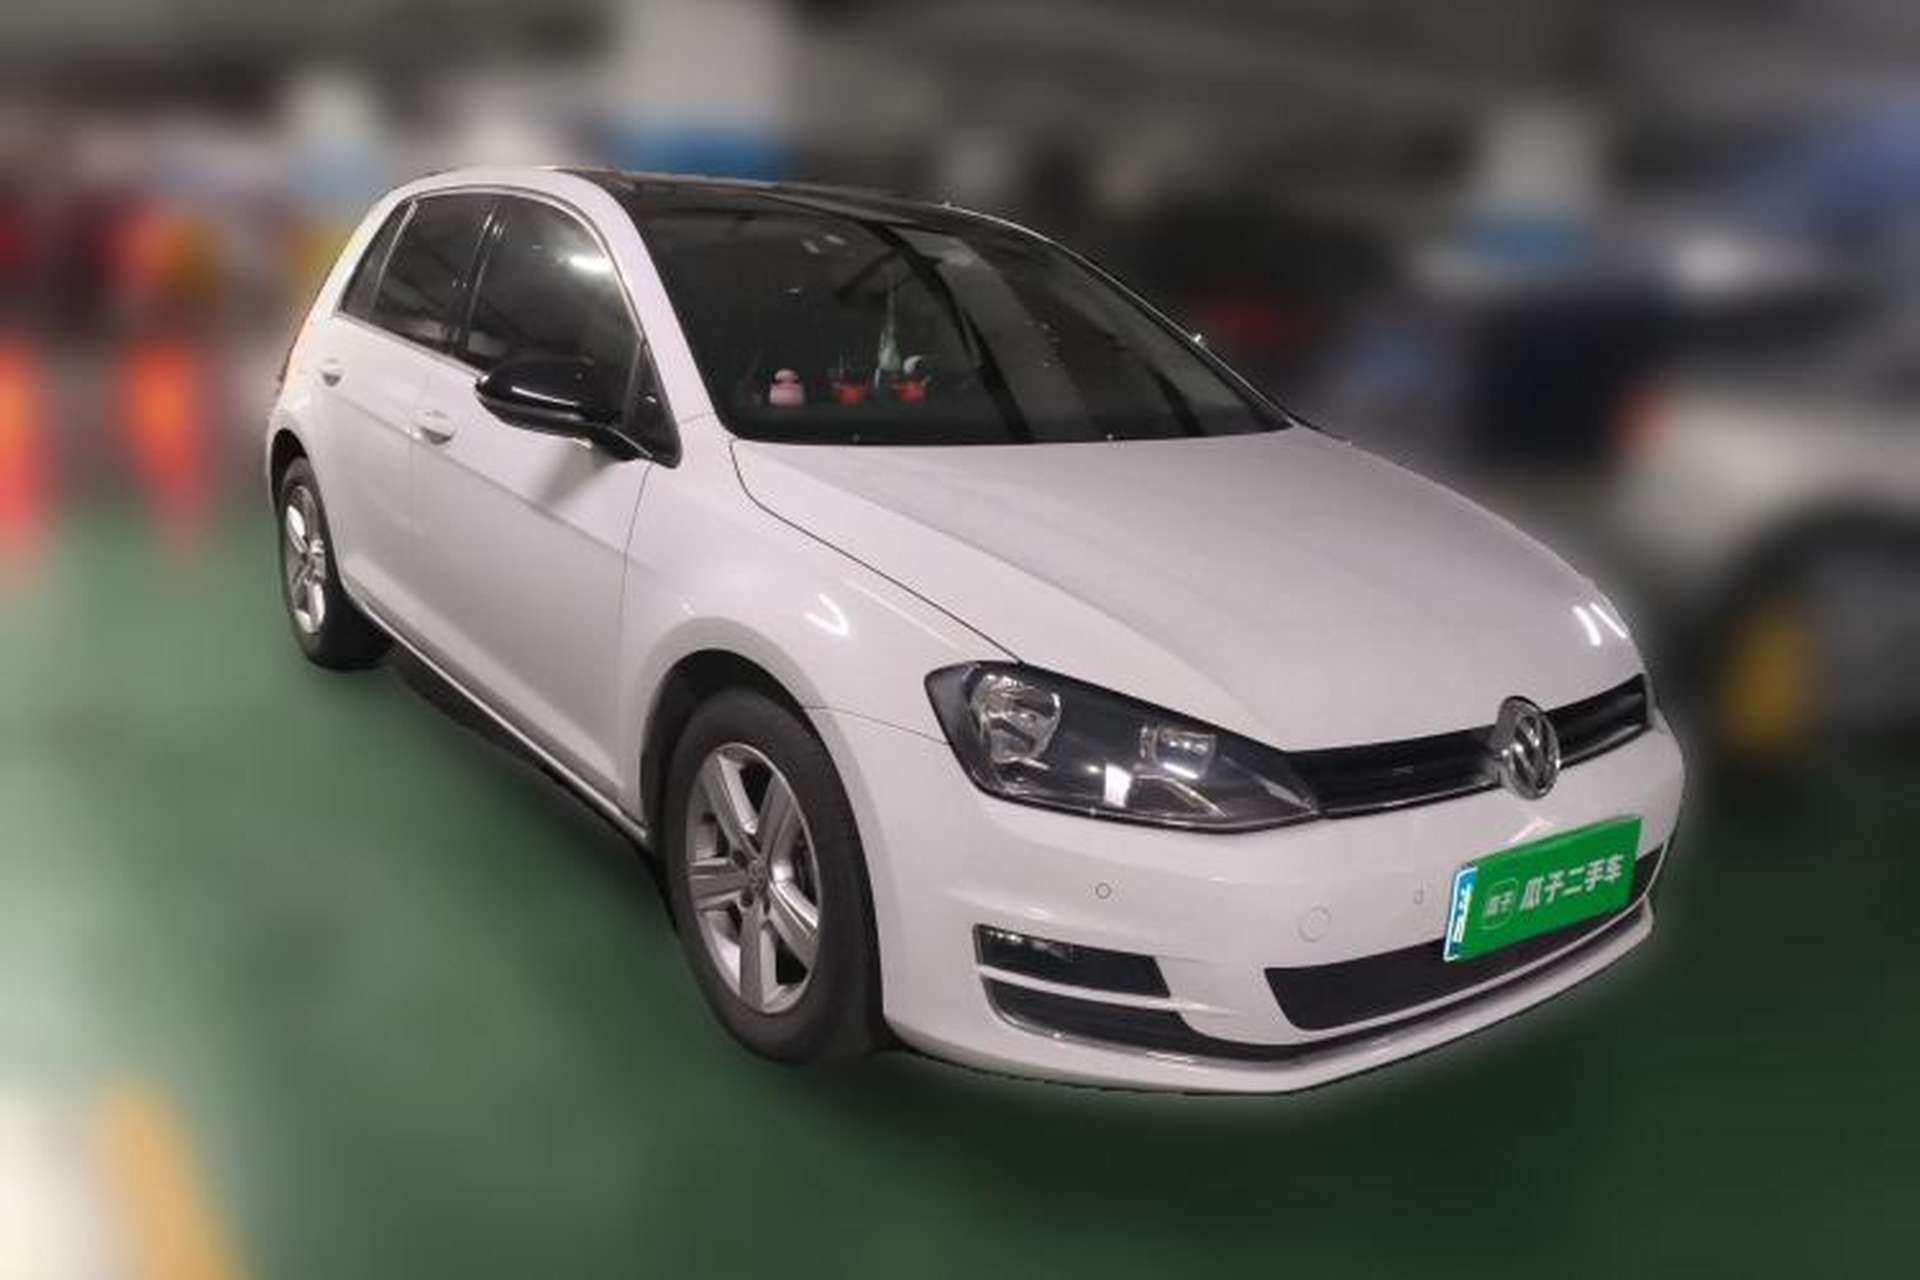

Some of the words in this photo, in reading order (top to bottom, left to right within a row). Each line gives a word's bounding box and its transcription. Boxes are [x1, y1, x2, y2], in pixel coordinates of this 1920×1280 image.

[1519, 854, 1624, 911] 瓜子二手车
